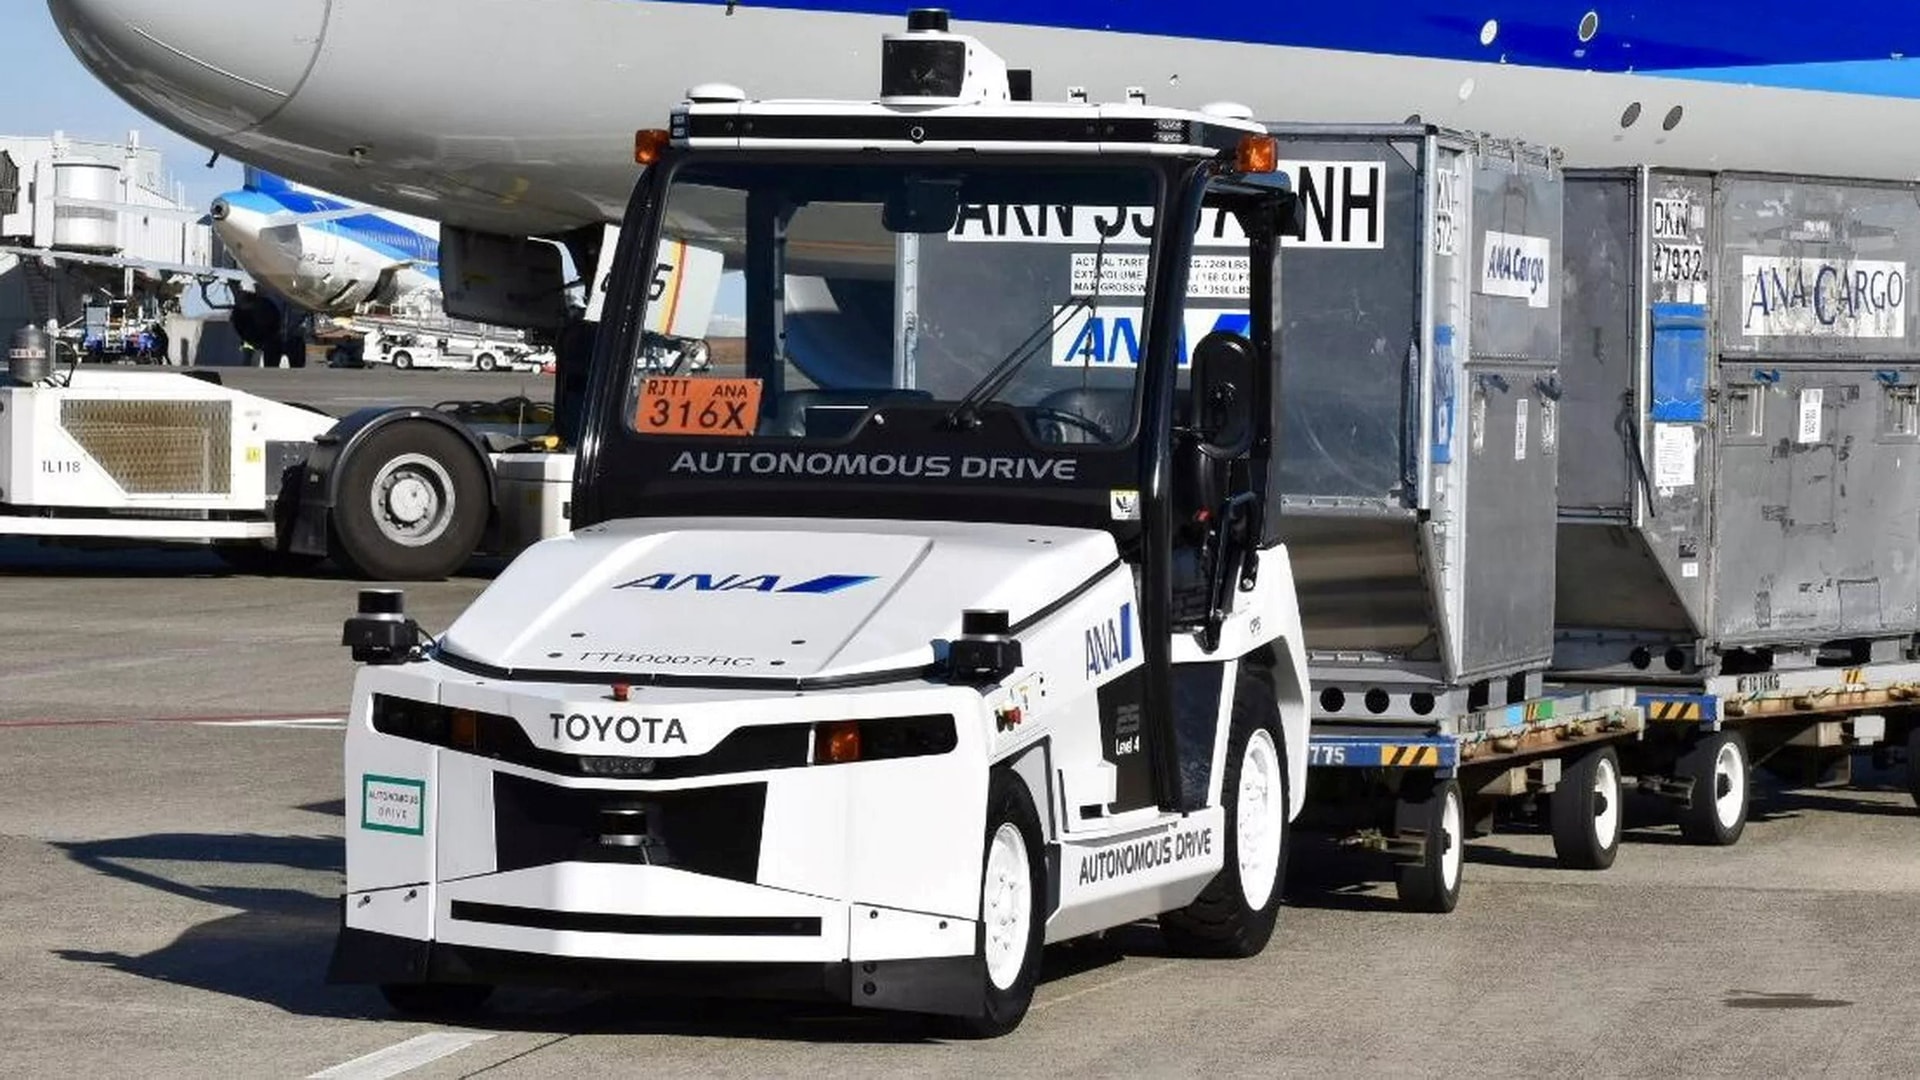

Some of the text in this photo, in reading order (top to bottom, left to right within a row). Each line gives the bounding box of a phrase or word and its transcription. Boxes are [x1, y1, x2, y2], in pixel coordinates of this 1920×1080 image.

[1075, 257, 1115, 267] ACTAL
[1487, 245, 1545, 294] ANA Cargo
[1744, 264, 1904, 329] ANA CARGO
[647, 380, 748, 398] RJTT ANA
[649, 398, 747, 430] 316X
[670, 450, 1077, 480] AUTONOMOUS DRIVE
[612, 573, 781, 592] ANA
[1084, 617, 1122, 681] ANA
[549, 712, 688, 744] TOYOTA
[1309, 745, 1346, 765] 775
[1079, 828, 1212, 886] AUTONOMOUS DRIVE
